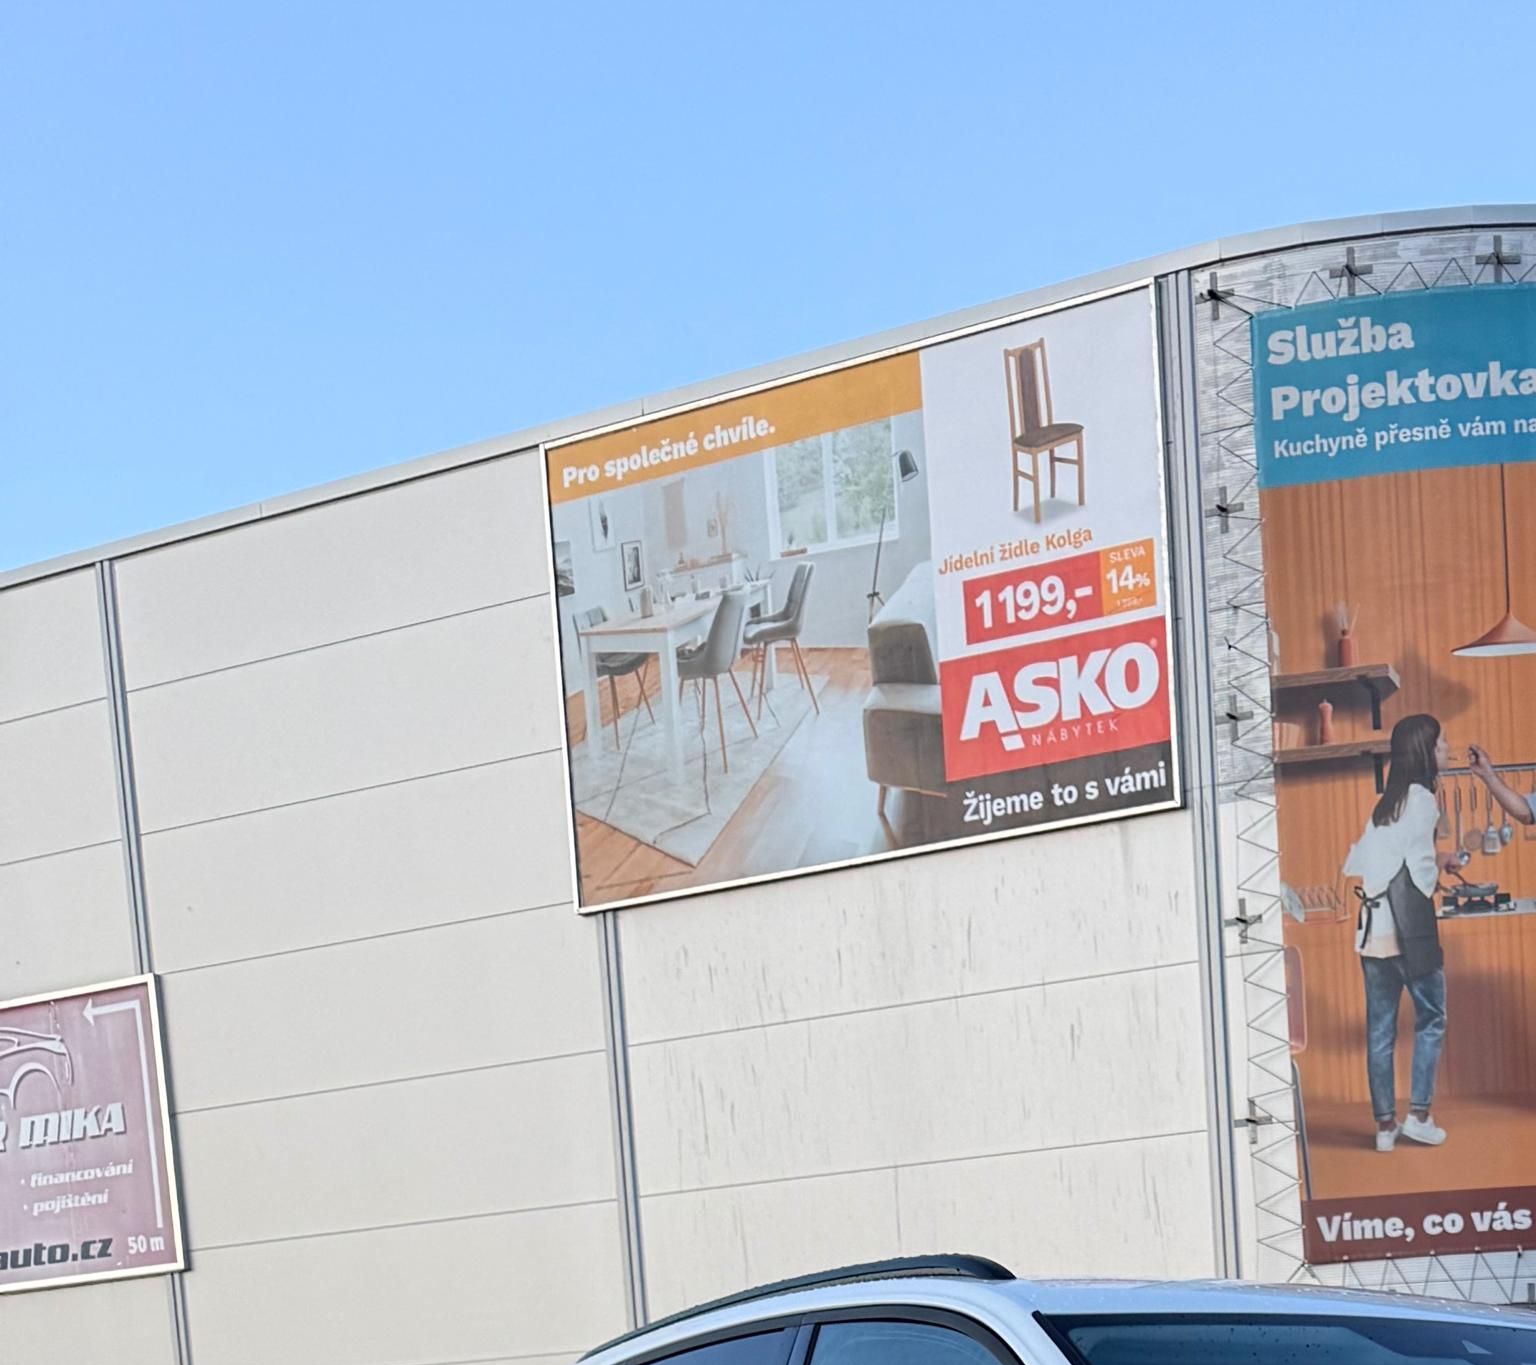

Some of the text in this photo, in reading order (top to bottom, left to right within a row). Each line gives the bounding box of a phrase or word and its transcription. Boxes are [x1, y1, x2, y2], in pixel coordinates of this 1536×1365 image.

[1267, 316, 1415, 365] Služba
[562, 416, 776, 488] Pro společné chvíle.
[1273, 427, 1367, 459] Kuchyně
[1374, 418, 1451, 451] přesně
[1458, 416, 1506, 438] vám
[938, 528, 1093, 575] Jídelní židle Kolga
[1109, 545, 1146, 563] SLEVA
[1106, 565, 1151, 594] 14%
[959, 642, 1160, 751] ASKO
[1031, 719, 1119, 746] NÁBYTEK
[963, 760, 1167, 825] Žijeme to s vámi
[18, 1102, 127, 1149] MIKA
[30, 1159, 134, 1188] financování
[33, 1188, 109, 1216] pojištění
[1316, 1212, 1415, 1242] Víme,
[1422, 1212, 1464, 1235] co
[1470, 1202, 1532, 1232] vás
[128, 1235, 165, 1254] 50 m
